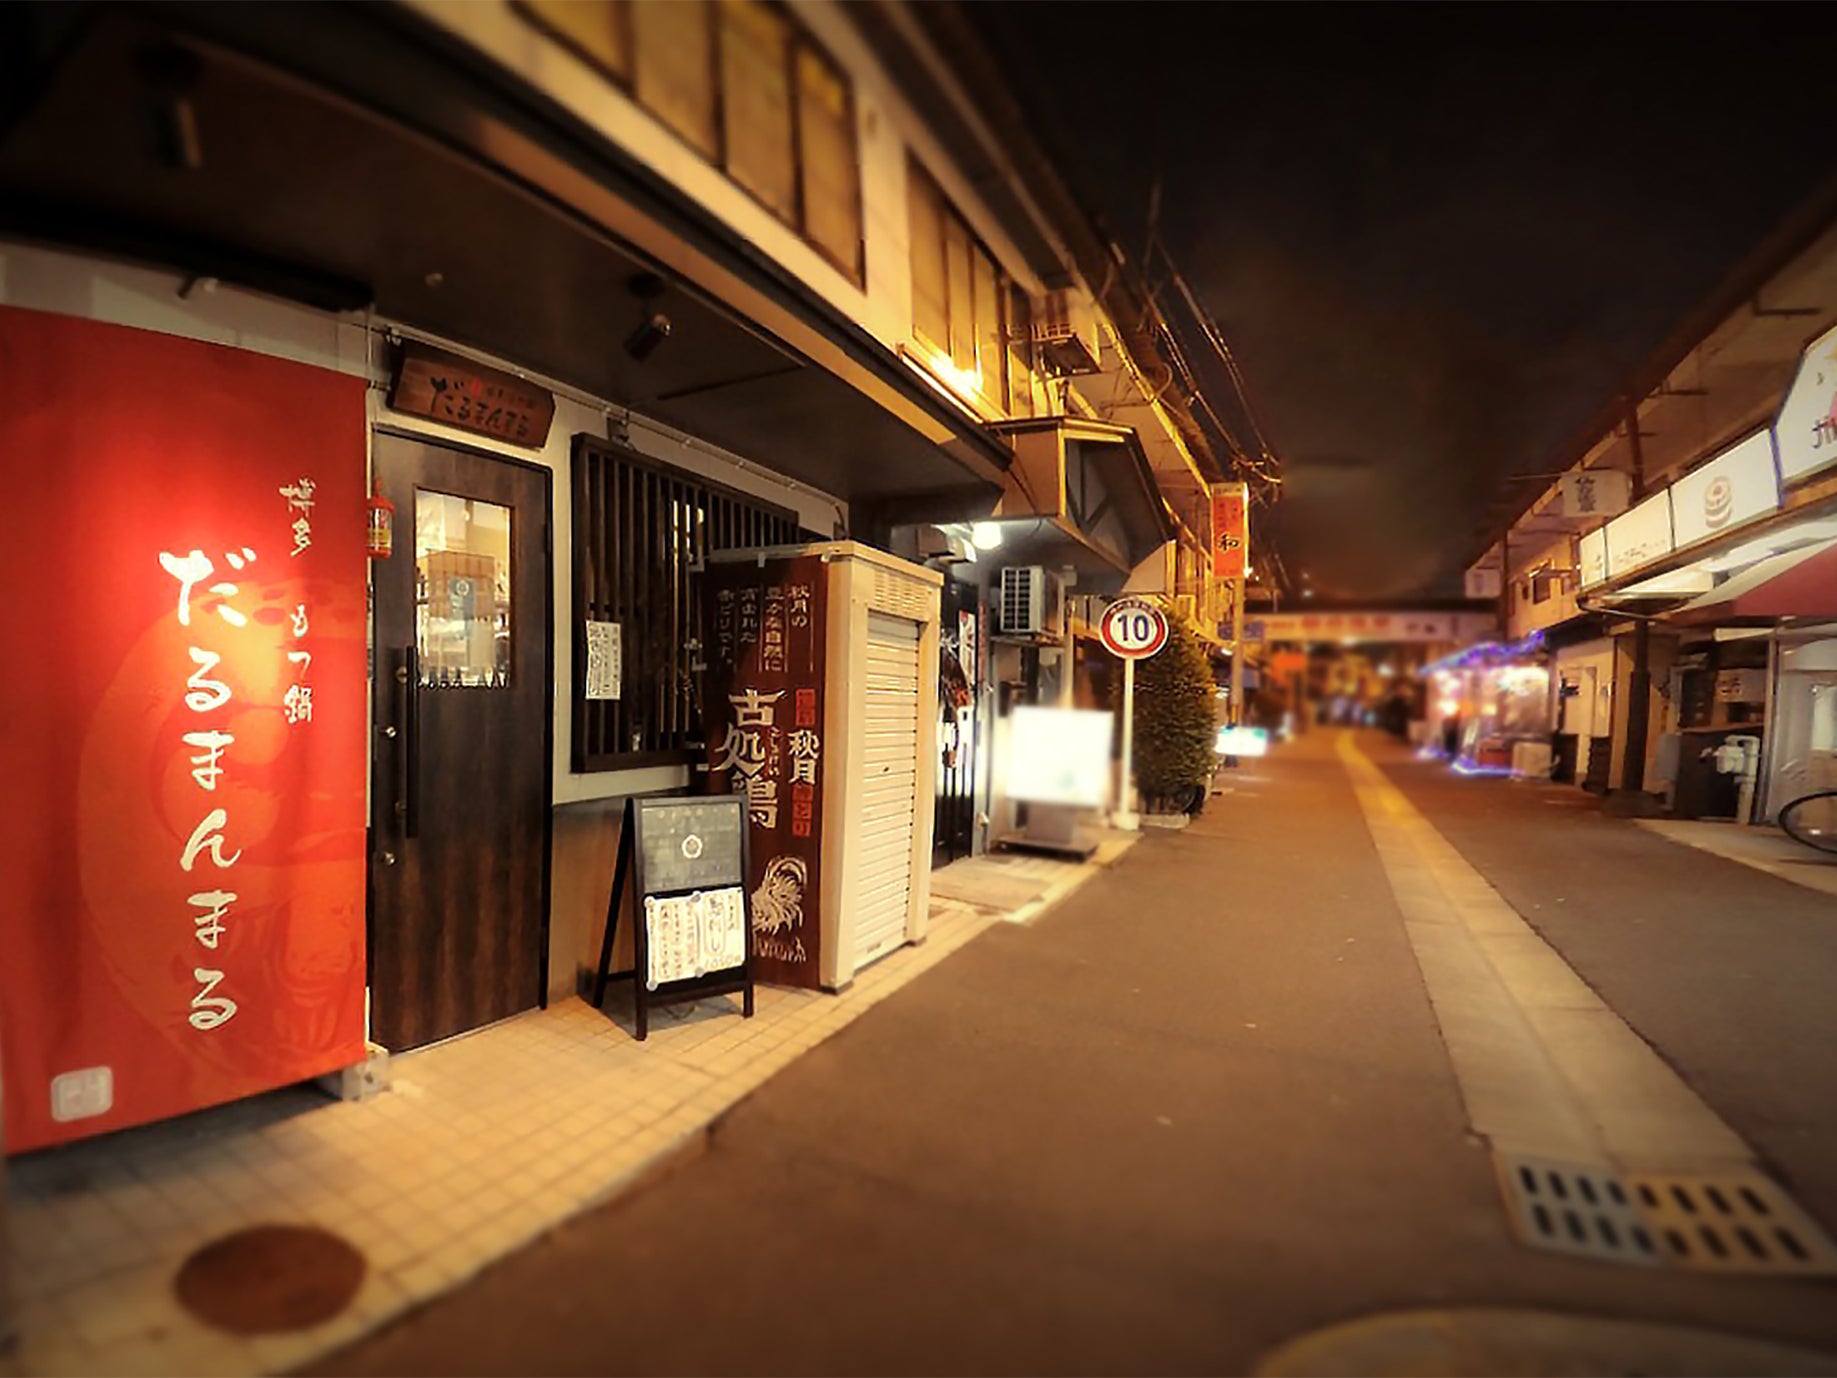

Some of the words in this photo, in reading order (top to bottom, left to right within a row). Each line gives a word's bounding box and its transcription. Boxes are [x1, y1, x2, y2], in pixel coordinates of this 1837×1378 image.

[279, 477, 316, 557] 博多
[1217, 533, 1240, 553] 和
[787, 584, 811, 629] 秋月の
[1115, 613, 1149, 642] 10
[284, 603, 313, 724] もつ鍋
[787, 729, 821, 785] 秋月
[158, 546, 257, 1031] だるまんまる
